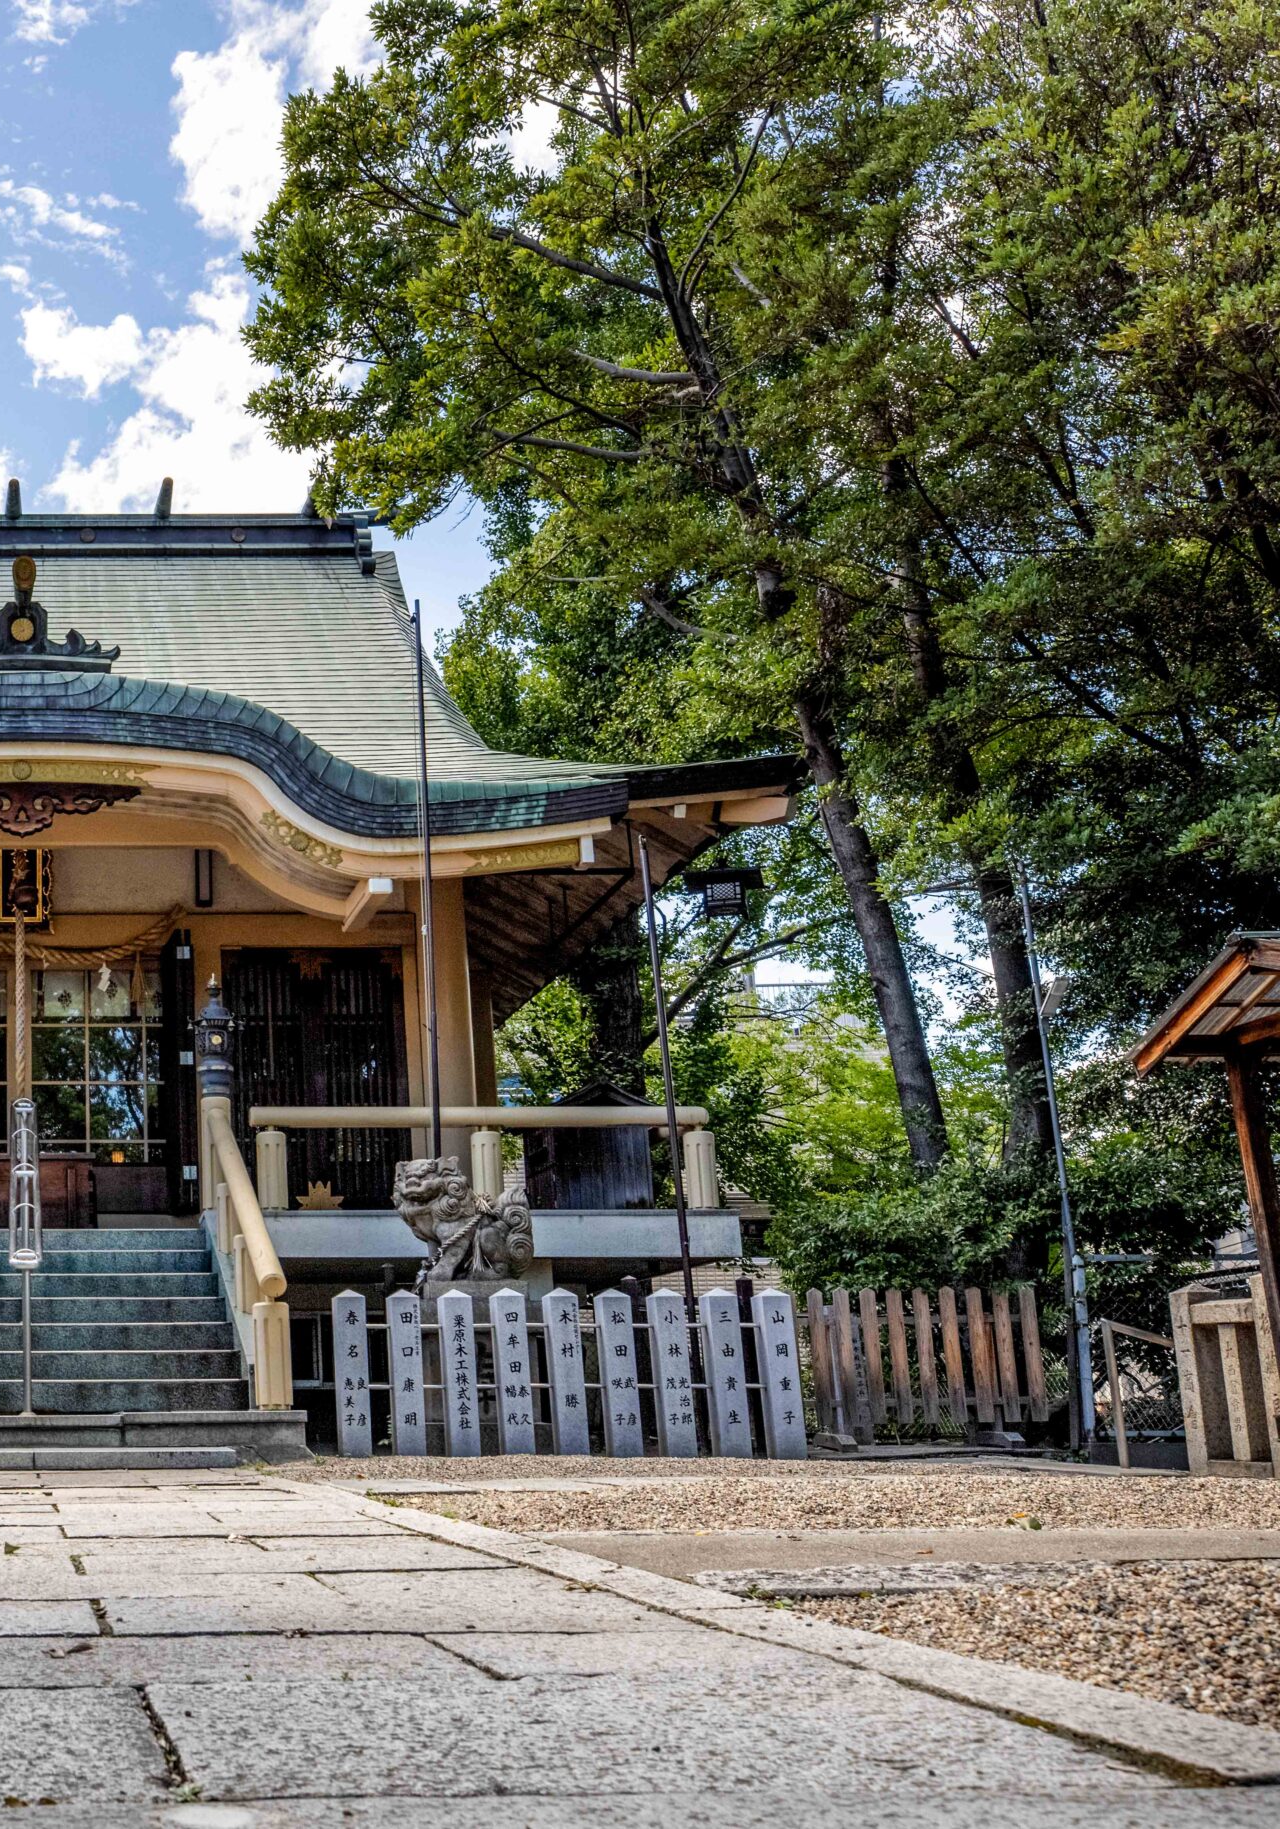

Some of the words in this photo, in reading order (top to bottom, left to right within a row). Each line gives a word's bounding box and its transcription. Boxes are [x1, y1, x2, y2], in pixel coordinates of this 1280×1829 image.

[345, 1310, 359, 1358] 春名
[505, 1311, 522, 1374] 四牟田
[611, 1310, 628, 1357] 松田
[664, 1310, 682, 1358] 小林
[400, 1311, 417, 1426] 田口康明
[452, 1314, 472, 1430] 栗原木工株式会社
[559, 1309, 580, 1408] 木村勝
[719, 1310, 742, 1425] 三由貴生
[771, 1310, 796, 1425] 山岡重子
[356, 1377, 368, 1426] 良彦
[517, 1385, 532, 1426] 泰久
[612, 1378, 626, 1426] 咲子
[624, 1377, 637, 1426] 武彦
[666, 1377, 680, 1426] 茂子
[678, 1377, 693, 1425] 光治郎
